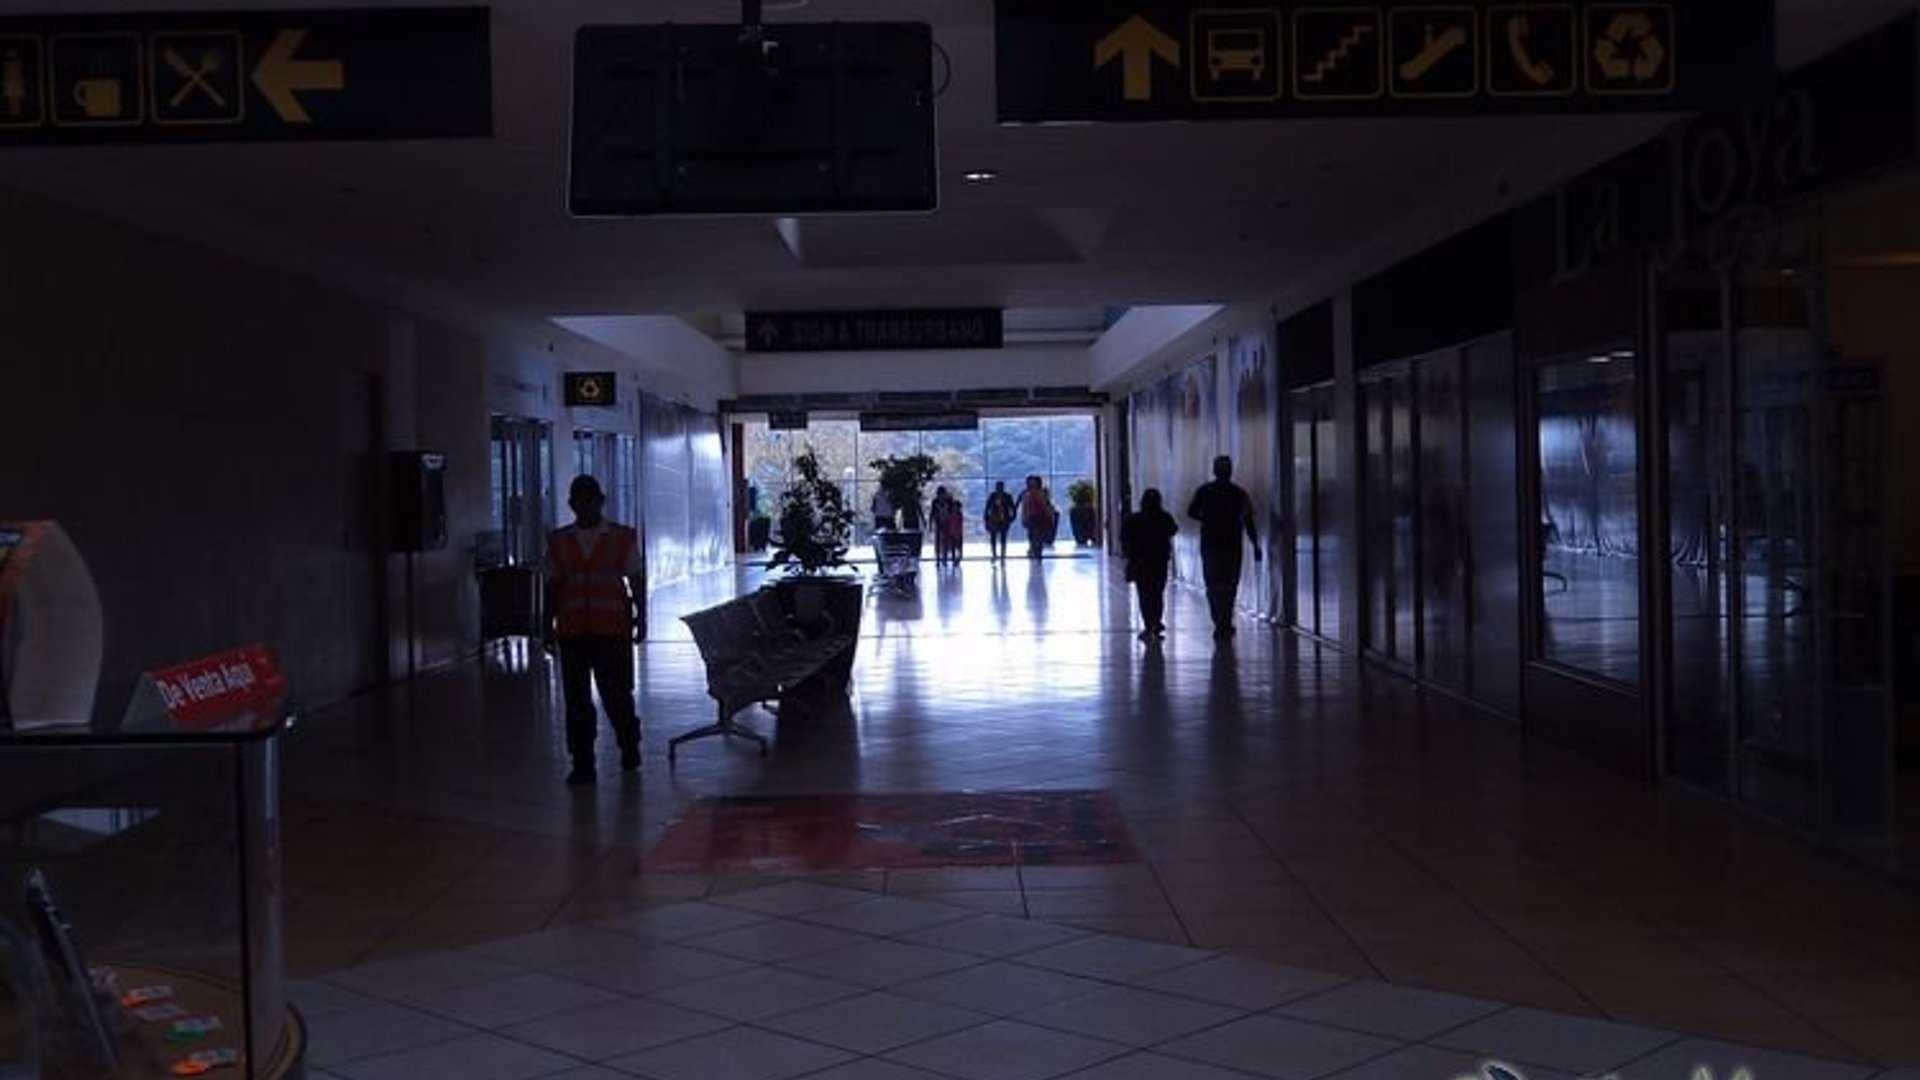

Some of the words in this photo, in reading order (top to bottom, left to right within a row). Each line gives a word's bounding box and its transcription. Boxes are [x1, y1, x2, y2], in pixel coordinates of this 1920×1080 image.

[1549, 177, 1620, 287] La
[1643, 88, 1821, 273] Joya
[155, 678, 187, 712] De
[177, 668, 227, 703] Venta
